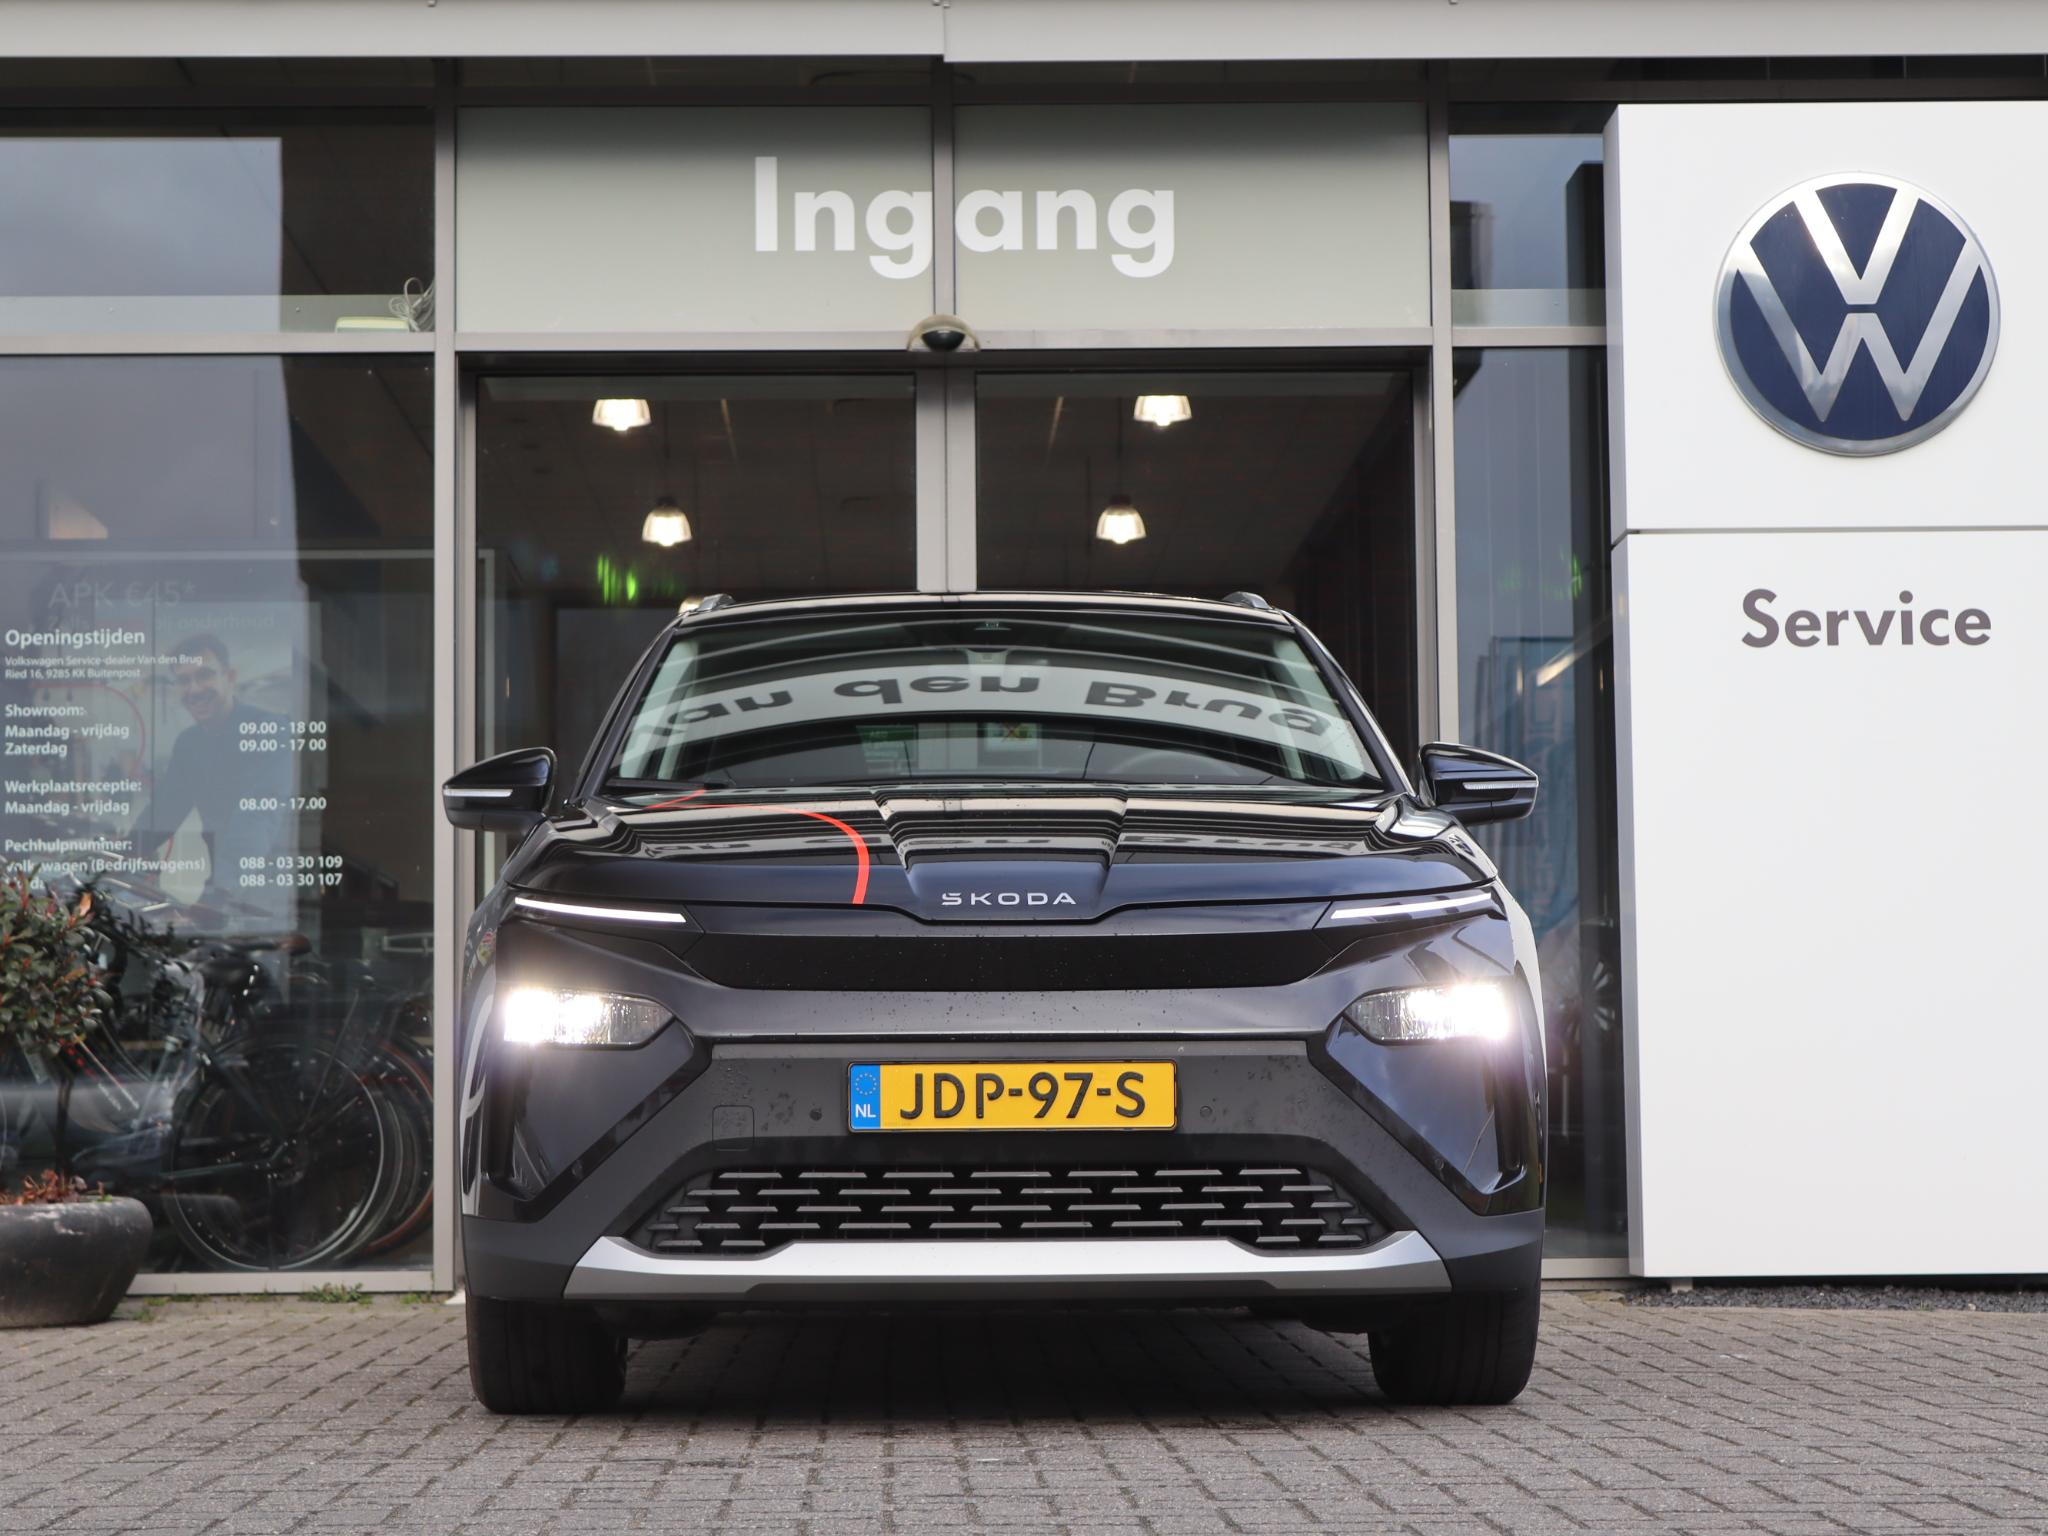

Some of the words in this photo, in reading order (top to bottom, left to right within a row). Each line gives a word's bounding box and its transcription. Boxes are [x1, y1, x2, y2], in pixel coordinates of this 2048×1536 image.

[755, 157, 1175, 279] Ingang
[1742, 589, 1991, 648] Service
[5, 629, 145, 648] Openingstijden
[5, 656, 64, 667] Volkswagen
[138, 655, 157, 664] Van
[158, 654, 177, 664] den
[179, 654, 203, 665] Brug
[5, 669, 27, 679] Ried
[72, 669, 86, 678] KK
[88, 667, 141, 680] Buitenpost
[5, 704, 84, 717] Showroom:
[5, 724, 70, 740] Maandag
[81, 723, 130, 739] vrijdag
[240, 722, 278, 734] 09.00
[5, 741, 68, 757] Zaterdag
[240, 739, 278, 751] 09.00
[4, 779, 142, 795] Werkplaatsreceptie:
[5, 800, 70, 816] Maandag
[81, 799, 130, 815] vrijdag
[240, 798, 278, 810] 08.00
[290, 797, 327, 810] 17.00
[5, 838, 132, 853] Pechhulpnummer:
[91, 858, 206, 873] (Bedrijfswagens)
[240, 856, 266, 869] 088
[276, 856, 294, 868] 03
[297, 856, 314, 868] 30
[318, 855, 343, 868] 109
[240, 874, 266, 887] 088
[276, 873, 294, 886] 03
[297, 873, 314, 886] 30
[318, 872, 343, 886] 107
[941, 892, 1077, 906] SKODA
[855, 1103, 876, 1118] NL
[900, 1071, 1146, 1119] JDP-97-S
